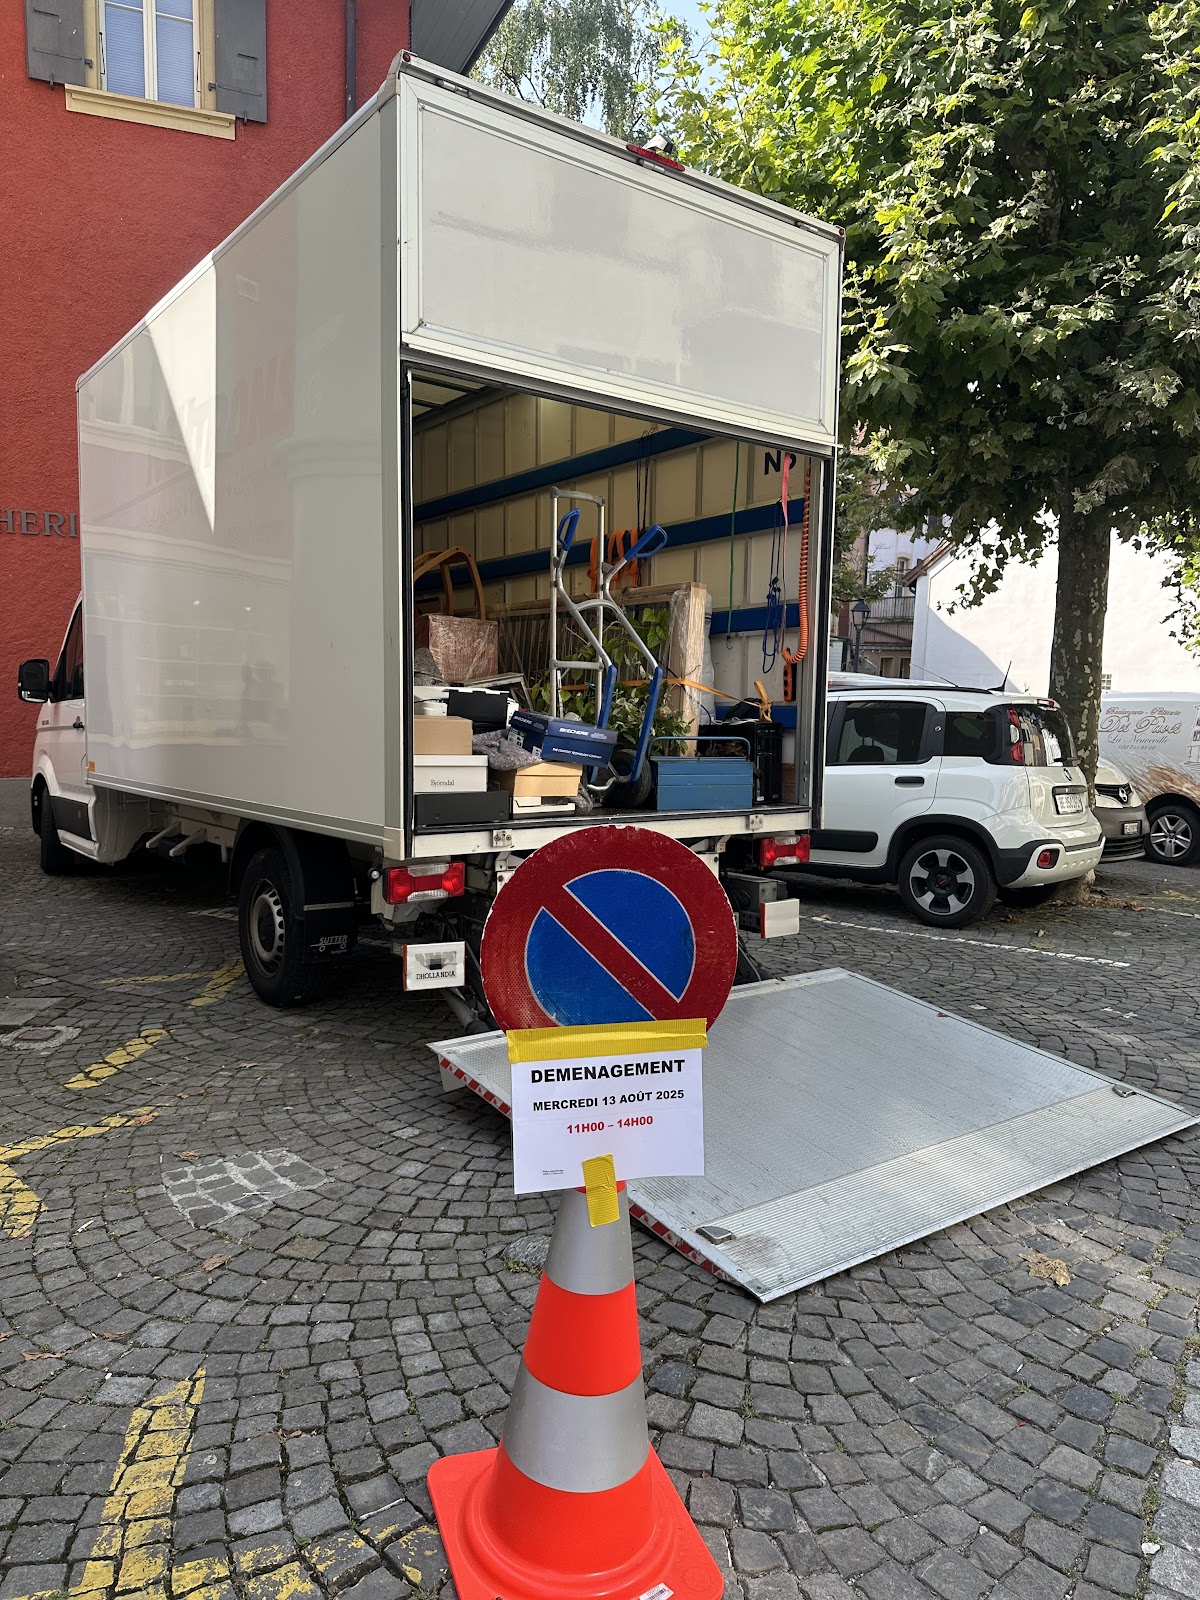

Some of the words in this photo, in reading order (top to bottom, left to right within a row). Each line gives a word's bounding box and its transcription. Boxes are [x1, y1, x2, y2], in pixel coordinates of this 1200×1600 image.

[0, 509, 78, 538] HERI
[559, 727, 589, 736] SKECHERS
[1098, 715, 1131, 733] Des
[1134, 715, 1182, 734] Pavés
[1107, 733, 1121, 743] La
[1124, 733, 1169, 744] Neuveville
[320, 935, 347, 944] SUTTER
[416, 970, 456, 980] DHOLLANDIA
[531, 1059, 685, 1083] DEMENAGEMENT
[533, 1097, 598, 1112] MERCREDI
[602, 1096, 616, 1106] 13
[619, 1091, 652, 1104] AOÛT
[656, 1089, 684, 1100] 2025
[567, 1121, 605, 1134] 11H00
[617, 1115, 653, 1128] 14H00
